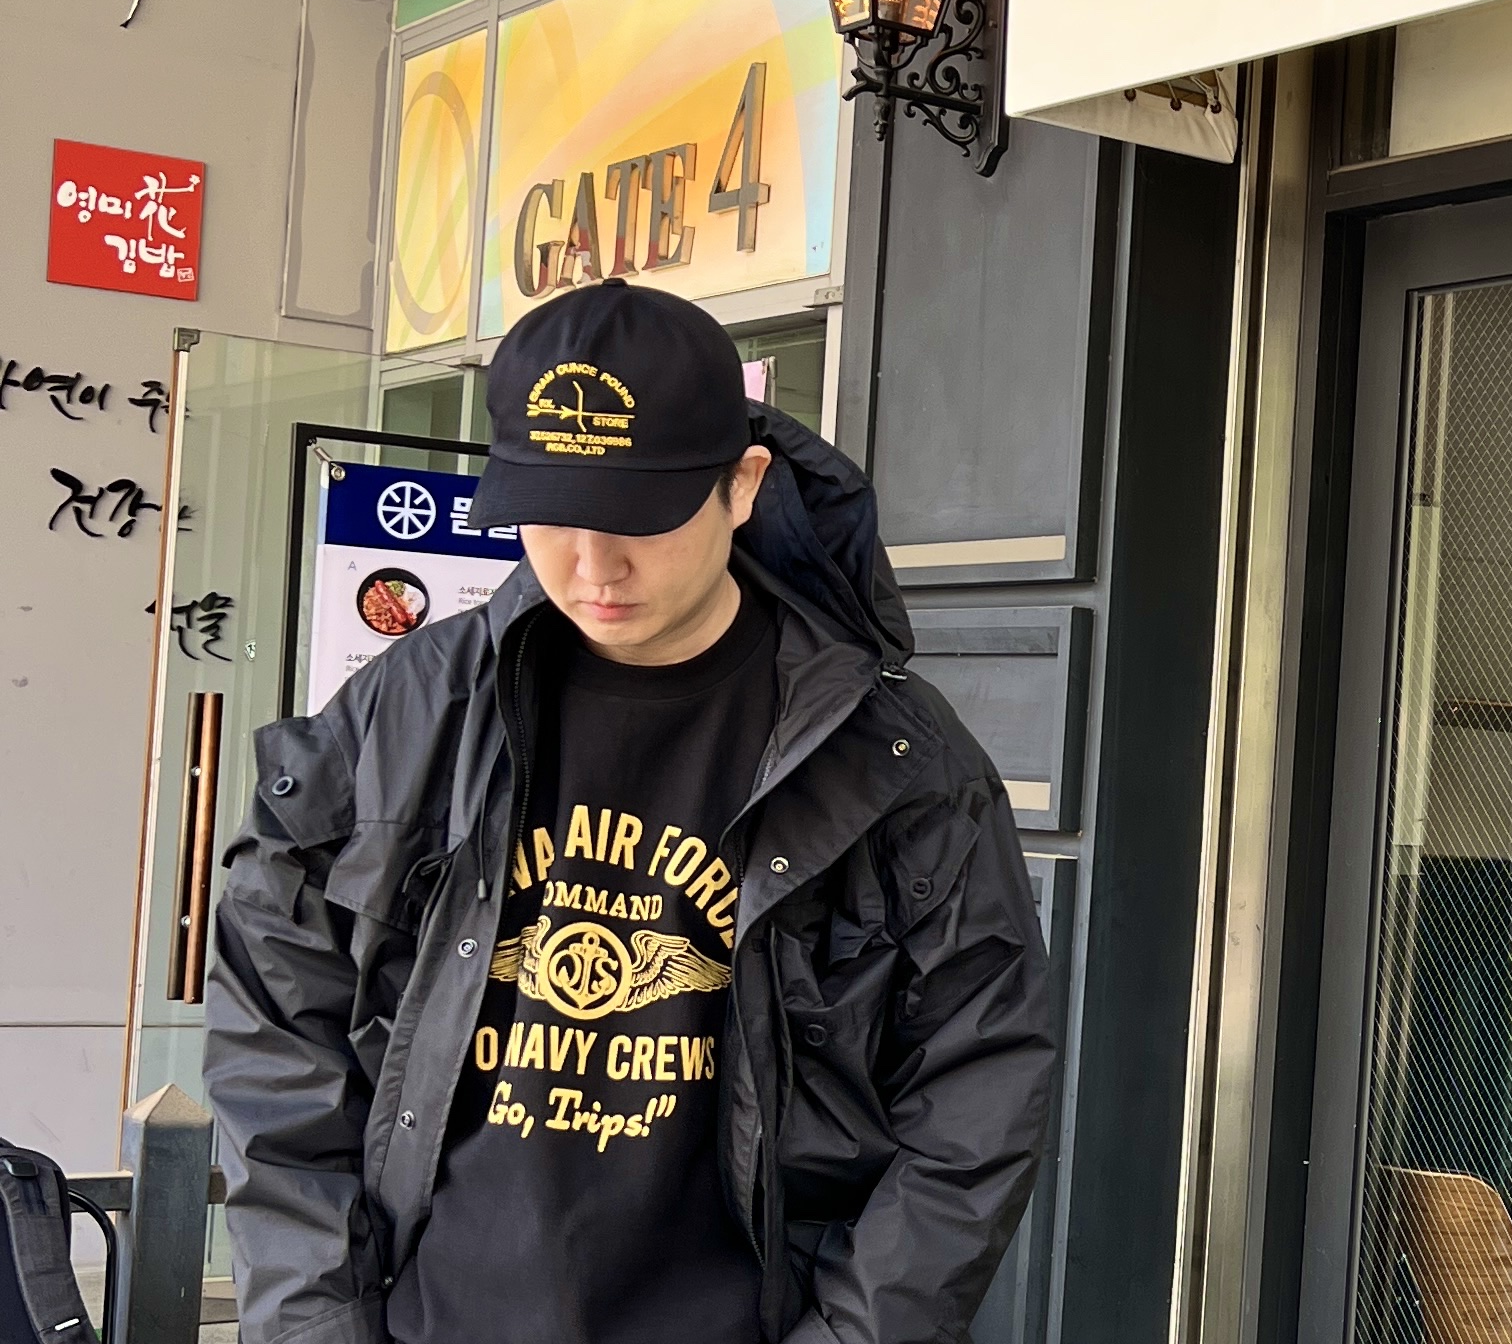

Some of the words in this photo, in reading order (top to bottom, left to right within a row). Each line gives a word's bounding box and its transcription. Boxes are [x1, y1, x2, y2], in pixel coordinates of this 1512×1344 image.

[515, 142, 698, 299] GATE
[708, 61, 771, 254] 4
[104, 234, 185, 278] 김밥
[555, 362, 599, 377] OUNCE
[599, 372, 636, 409] POUND
[592, 416, 629, 429] STORE
[48, 467, 199, 538] 건강
[564, 804, 644, 871] AIR
[542, 880, 663, 921] OMMAND
[475, 1025, 499, 1071] O
[504, 1021, 599, 1075] NAVY
[606, 1034, 715, 1082] CREWS
